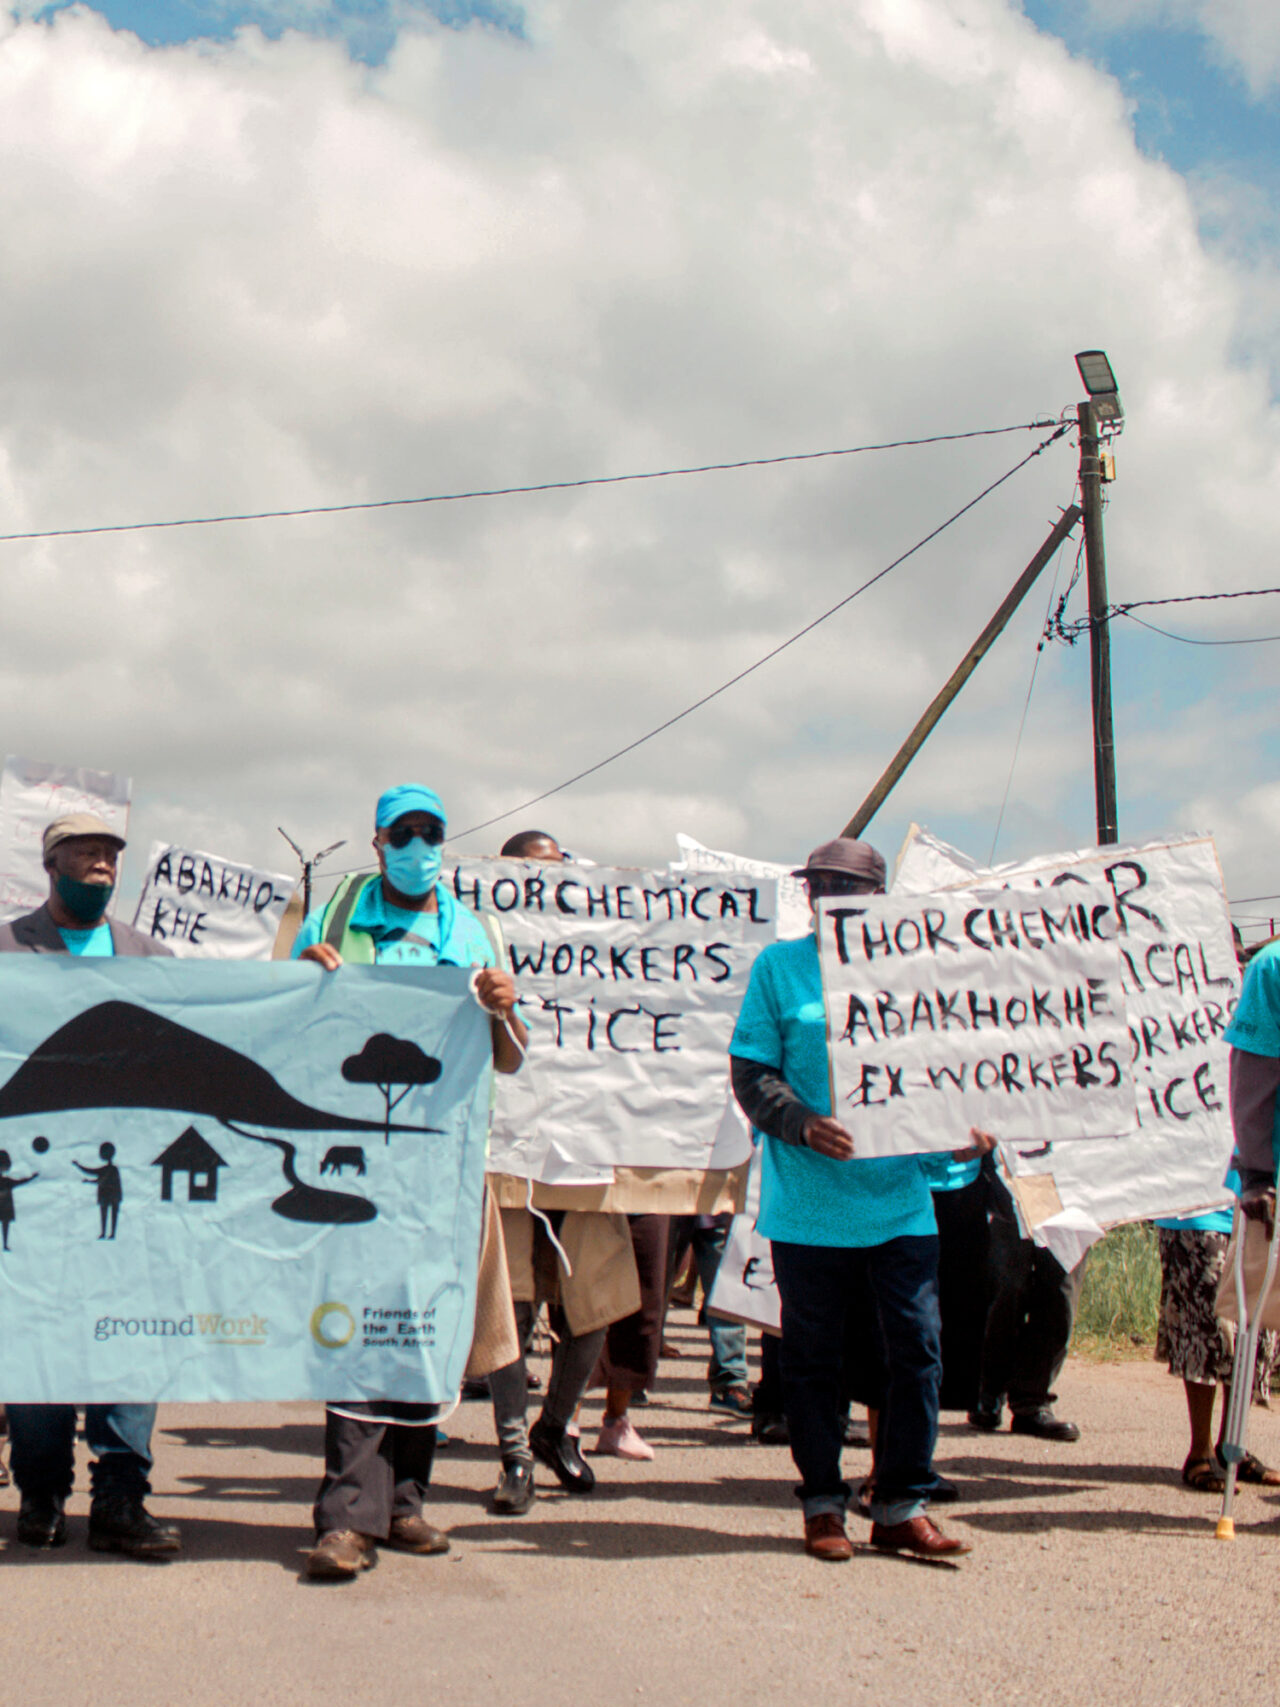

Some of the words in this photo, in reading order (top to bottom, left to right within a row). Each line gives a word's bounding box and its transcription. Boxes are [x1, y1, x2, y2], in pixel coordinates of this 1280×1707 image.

[154, 852, 287, 914] ABAKHO-
[453, 865, 769, 924] HORCHEMICAL
[151, 897, 208, 944] KHE
[509, 941, 733, 983] WORKERS
[1119, 942, 1234, 996] ICAL
[517, 995, 683, 1052] TICE
[839, 978, 1115, 1047] ABAKHOKHE
[846, 1041, 1122, 1108] EX-WORKERS
[1134, 1062, 1223, 1128] ICE
[94, 1314, 269, 1342] groundWork
[363, 1307, 418, 1320] Friends
[423, 1307, 436, 1320] of
[363, 1323, 389, 1335] the
[397, 1322, 436, 1335] Earth
